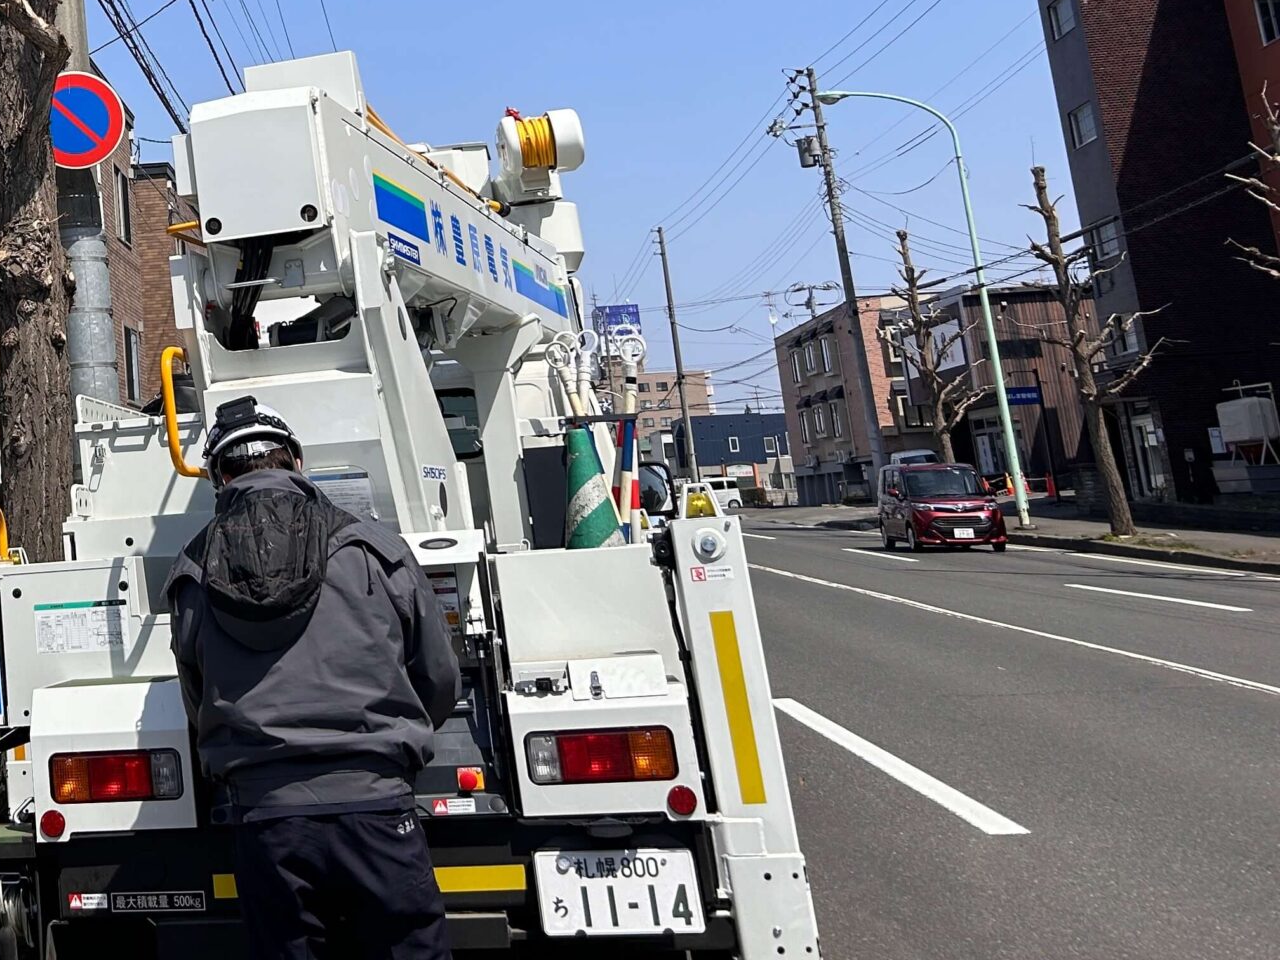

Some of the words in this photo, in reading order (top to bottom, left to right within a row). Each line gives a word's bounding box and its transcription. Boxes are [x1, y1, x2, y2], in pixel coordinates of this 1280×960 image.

[115, 894, 170, 909] 最大積載量
[173, 894, 202, 909] 500kg
[552, 896, 569, 918] ち
[580, 883, 694, 928] 11-14
